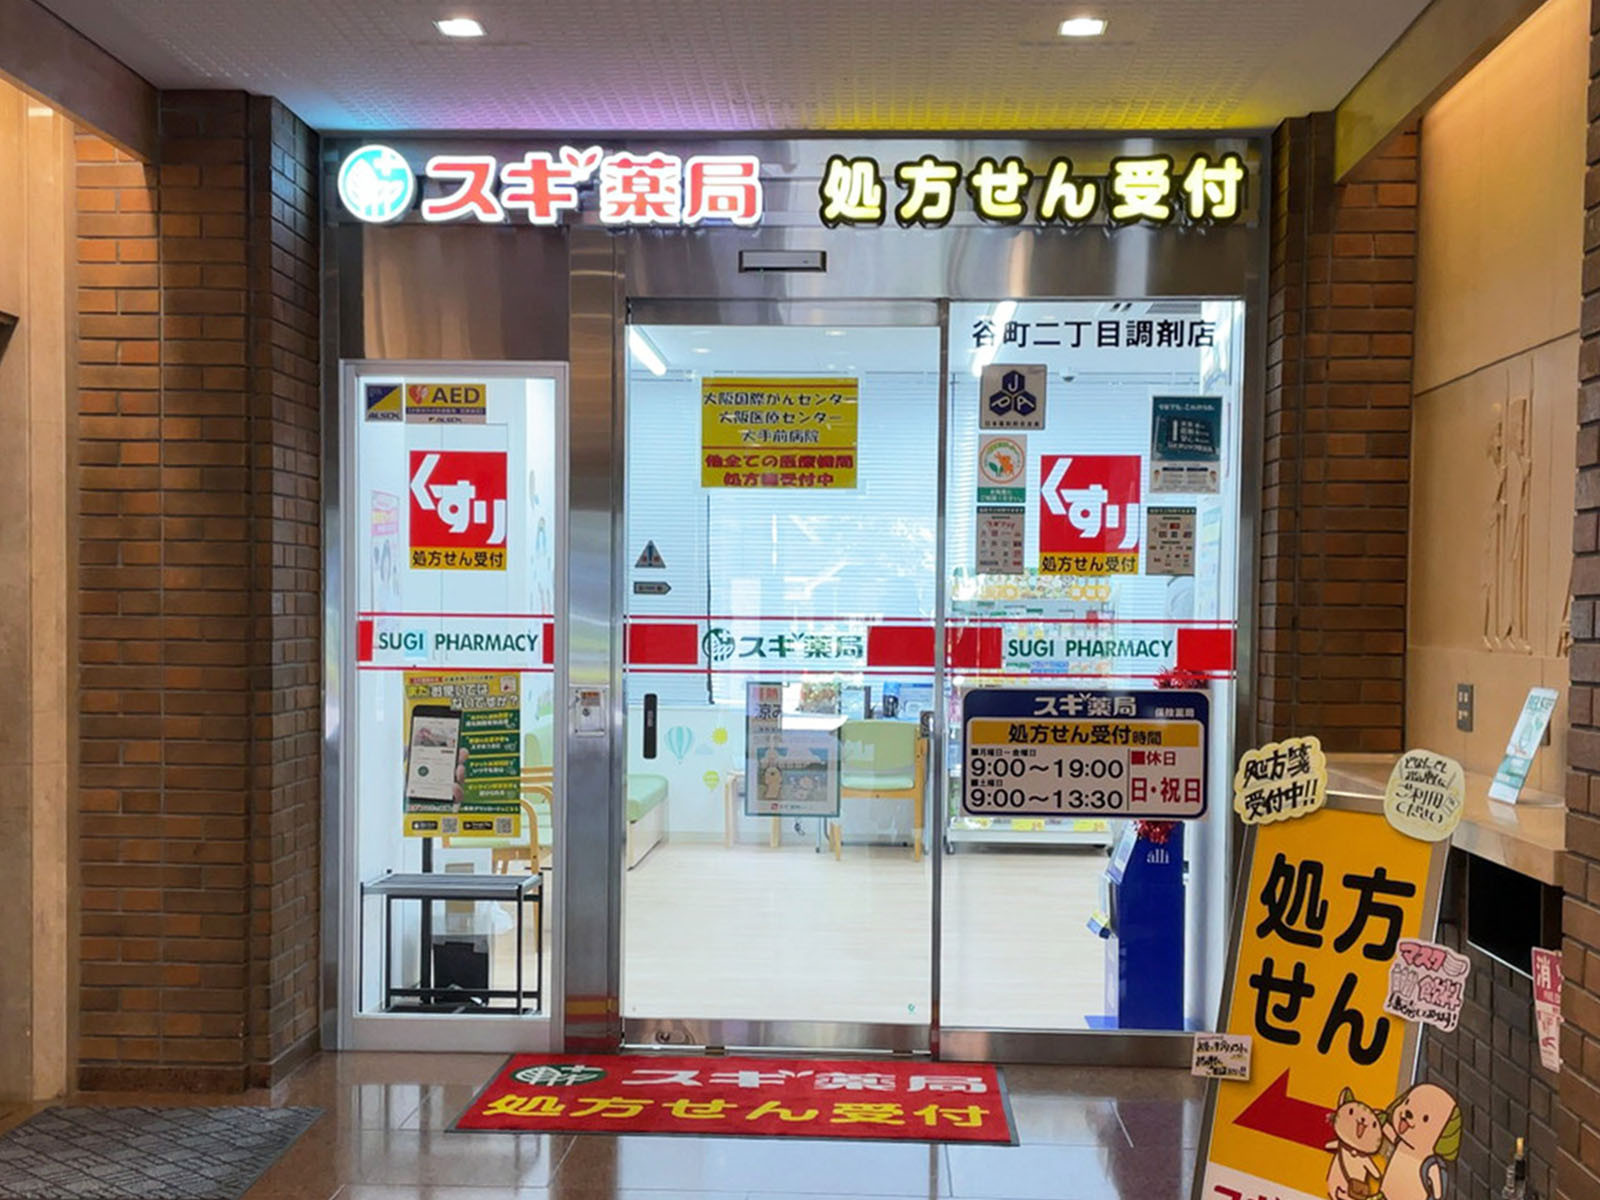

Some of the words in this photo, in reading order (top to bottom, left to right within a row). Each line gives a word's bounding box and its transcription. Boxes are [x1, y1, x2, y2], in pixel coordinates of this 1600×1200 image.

[423, 145, 763, 225] スギ薬局
[822, 155, 1244, 222] 処方せん受付
[971, 320, 1216, 349] 谷町二丁目調剤店
[431, 387, 480, 404] AED
[703, 391, 858, 406] 大阪国際がんセンター
[719, 410, 842, 424] 大阪医療センター
[742, 428, 820, 443] 大手前病院
[410, 453, 507, 545] くすり
[1040, 457, 1140, 549] くすり
[412, 550, 503, 568] 処方せん受付
[1042, 556, 1136, 573] 処方せん受付
[379, 632, 424, 650] SUGI
[434, 633, 539, 652] PHARMACY
[738, 632, 864, 659] スギ薬局
[1008, 639, 1055, 658] SUGI
[1065, 639, 1173, 659] PHARMACY
[1033, 693, 1137, 717] スギ薬局
[1008, 723, 1162, 746] 処方せん受付時間
[1146, 751, 1176, 766] 休日
[1131, 777, 1201, 804] 日・祝日
[1256, 852, 1416, 962] 処方
[1399, 942, 1448, 972] マスク
[1418, 975, 1462, 1011] 飲料
[1249, 956, 1390, 1066] せん
[621, 1067, 989, 1095] スギ薬局
[481, 1093, 990, 1128] 処方せん受付
